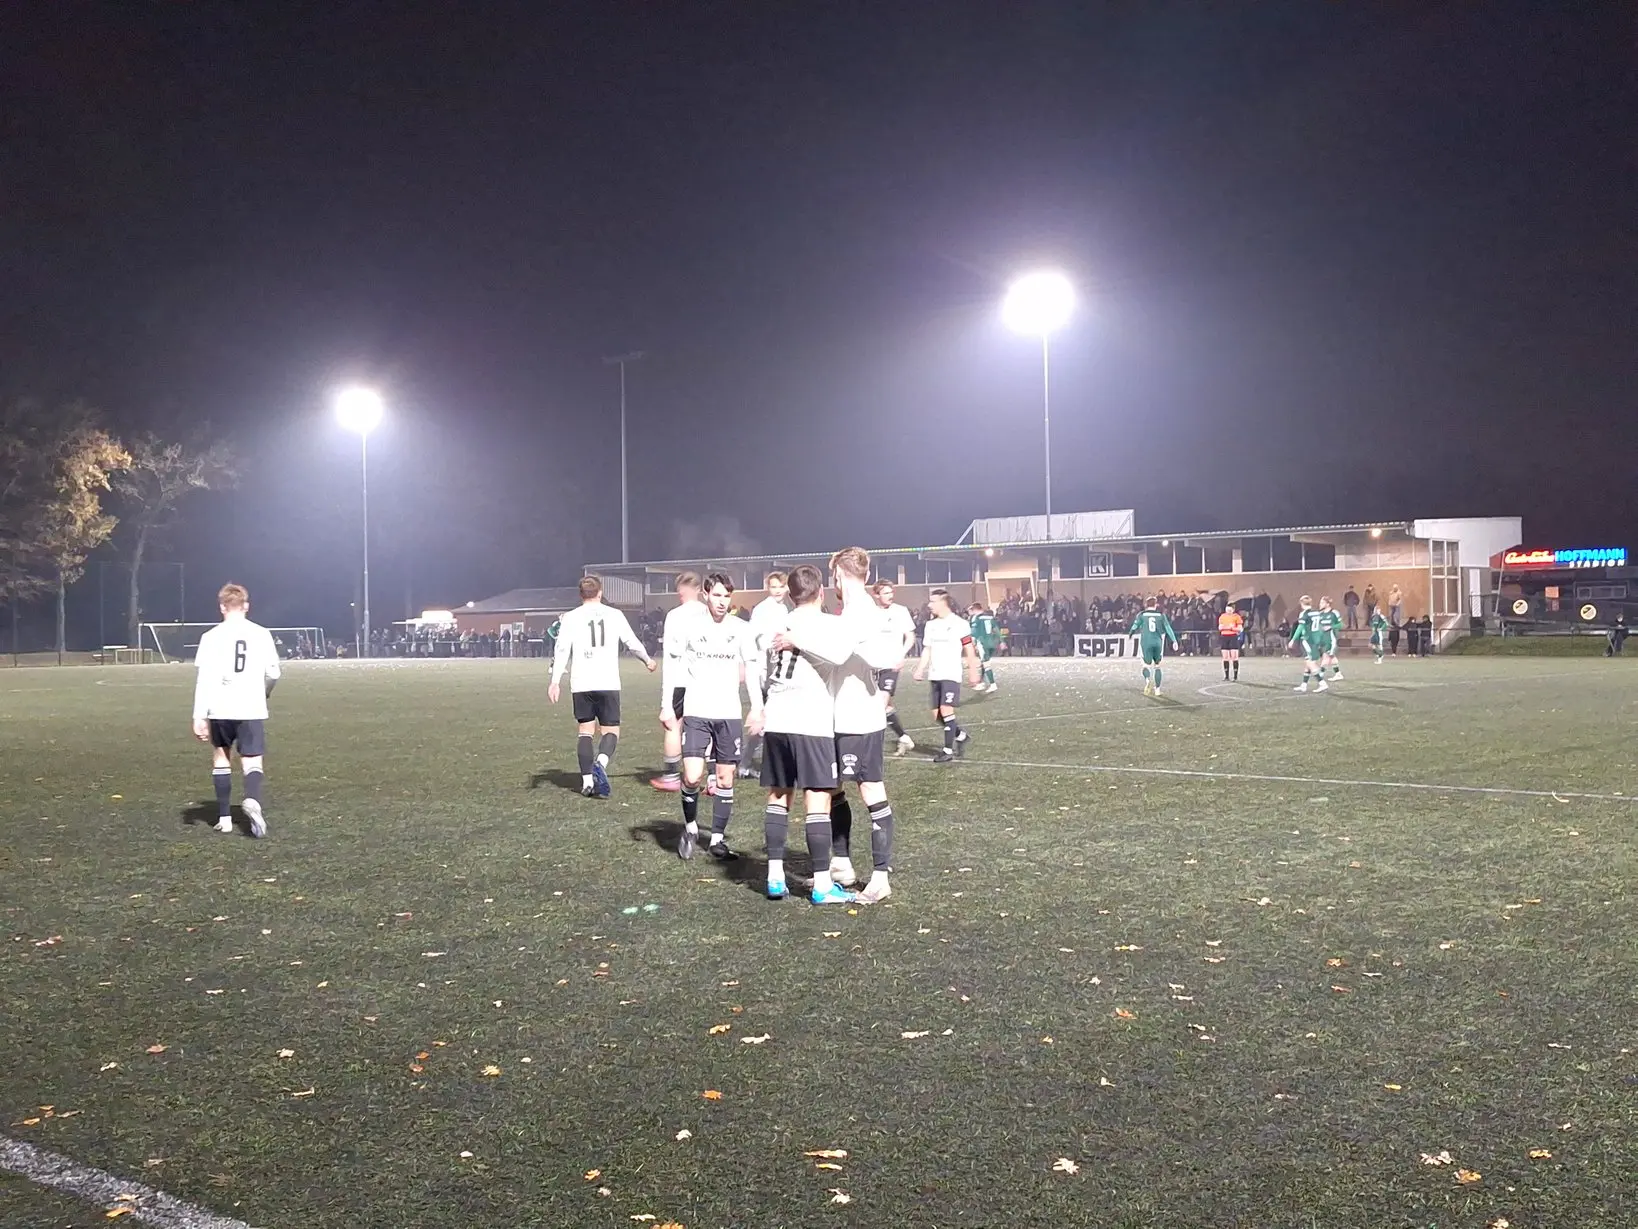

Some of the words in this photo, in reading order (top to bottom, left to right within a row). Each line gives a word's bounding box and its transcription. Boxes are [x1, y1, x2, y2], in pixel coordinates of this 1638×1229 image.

[1555, 548, 1625, 562] HOFFMANN
[1092, 556, 1106, 573] K
[1569, 559, 1625, 568] STADION
[588, 618, 605, 648] 11
[1148, 617, 1156, 633] 6
[234, 639, 247, 673] 6
